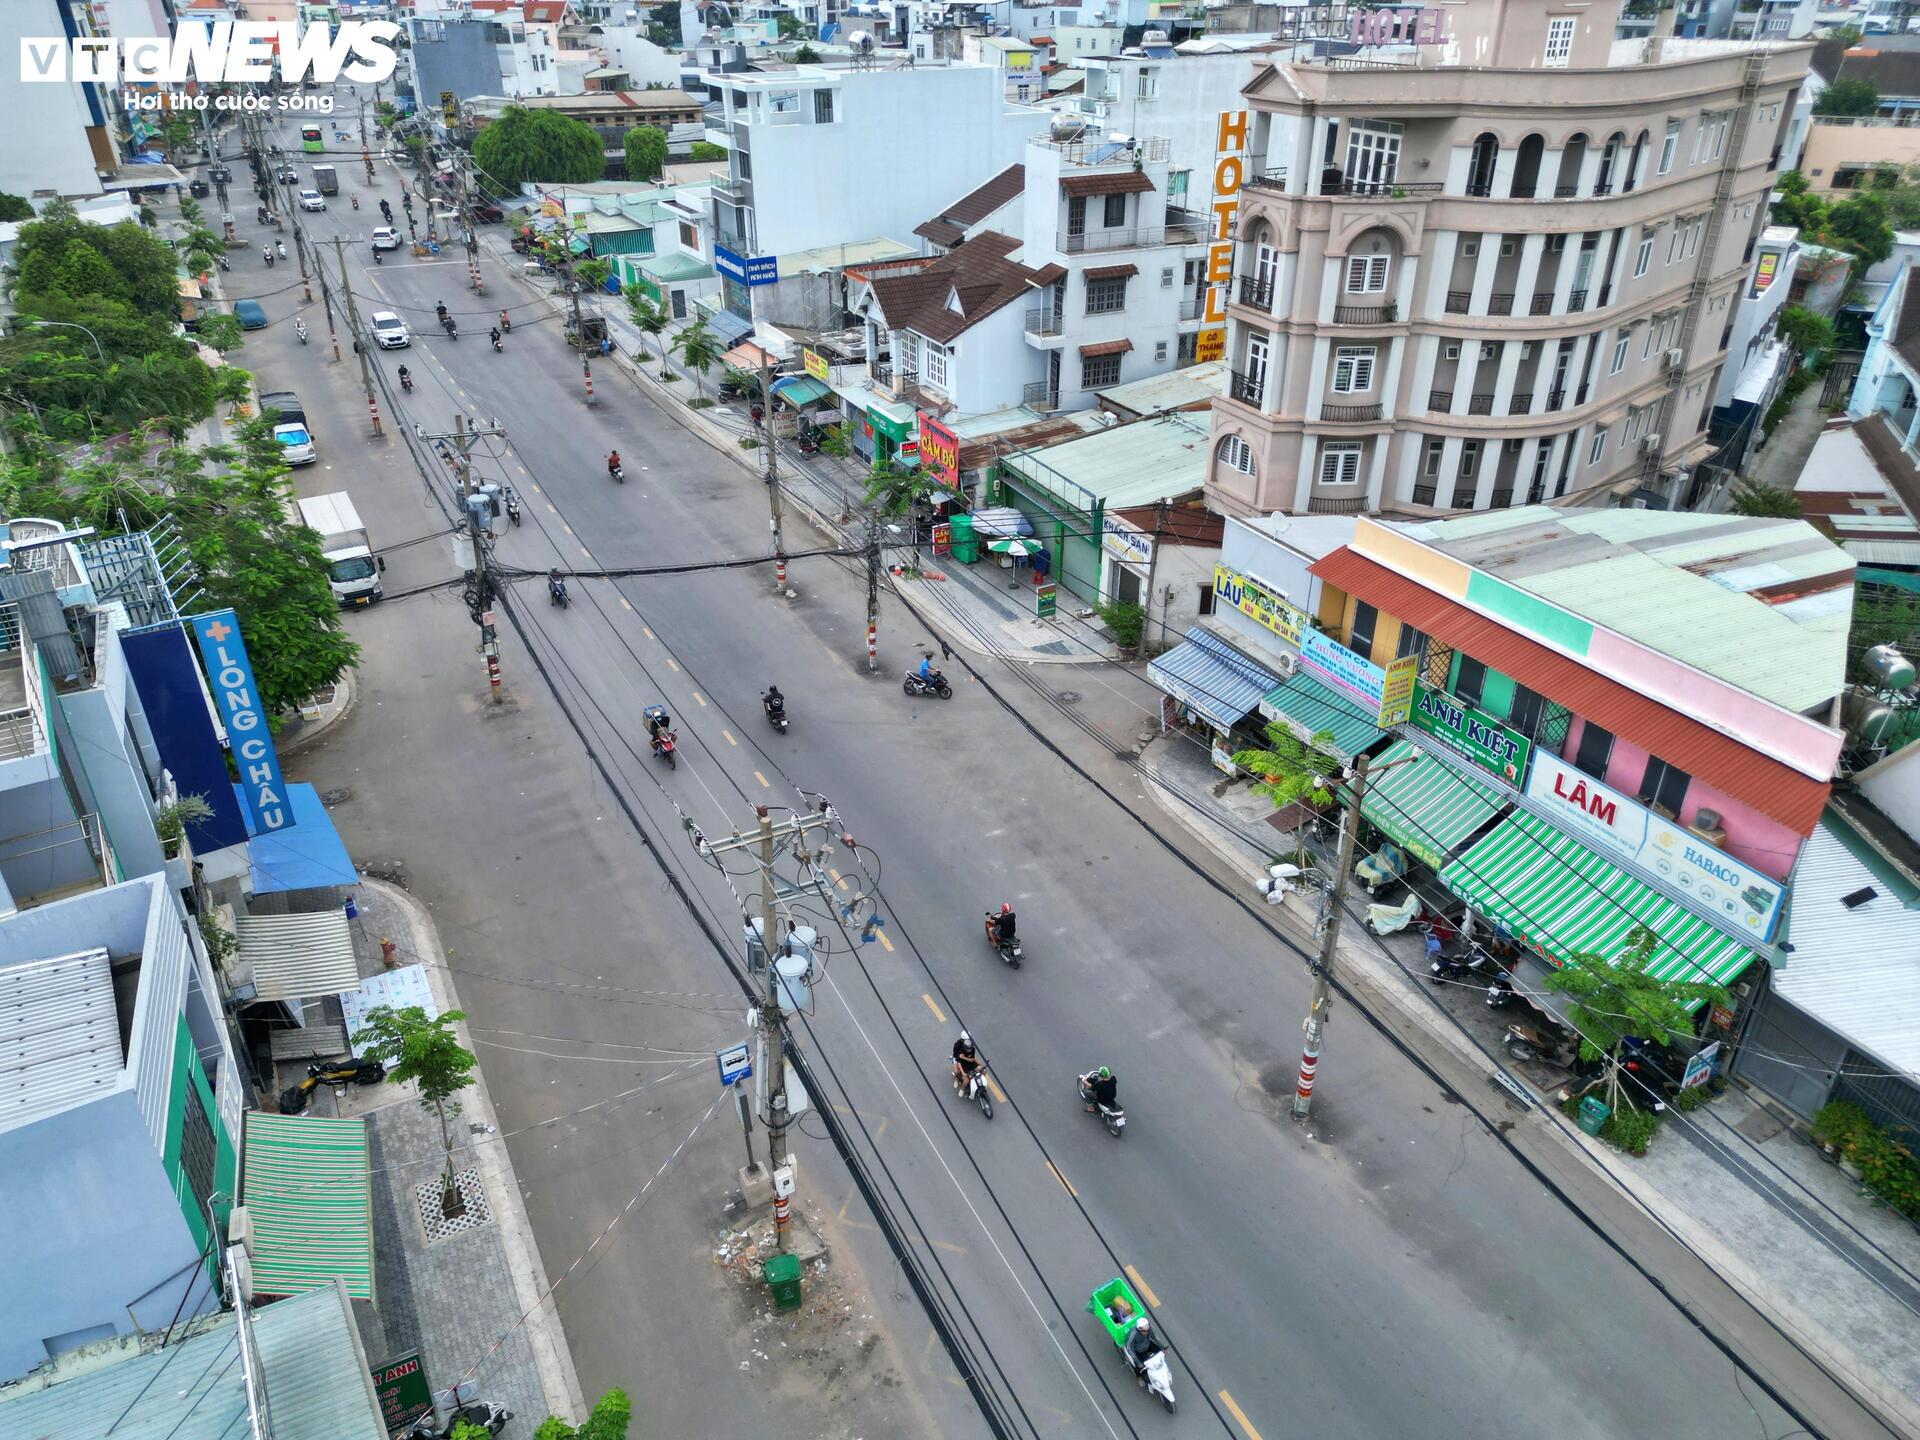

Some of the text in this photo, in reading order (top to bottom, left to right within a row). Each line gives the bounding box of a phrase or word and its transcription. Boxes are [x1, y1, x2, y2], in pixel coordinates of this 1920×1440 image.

[1351, 8, 1449, 48] HOTEL
[1202, 110, 1248, 324] HOTEL
[1199, 342, 1225, 352] THANG
[217, 646, 285, 828] LONG CHÂU
[1418, 692, 1464, 732] ANH
[1466, 717, 1519, 762] KIỆT
[1553, 772, 1617, 827] LÂM
[1683, 846, 1740, 887] HABACO
[1490, 911, 1512, 933] XE
[386, 1359, 419, 1383] ANH
